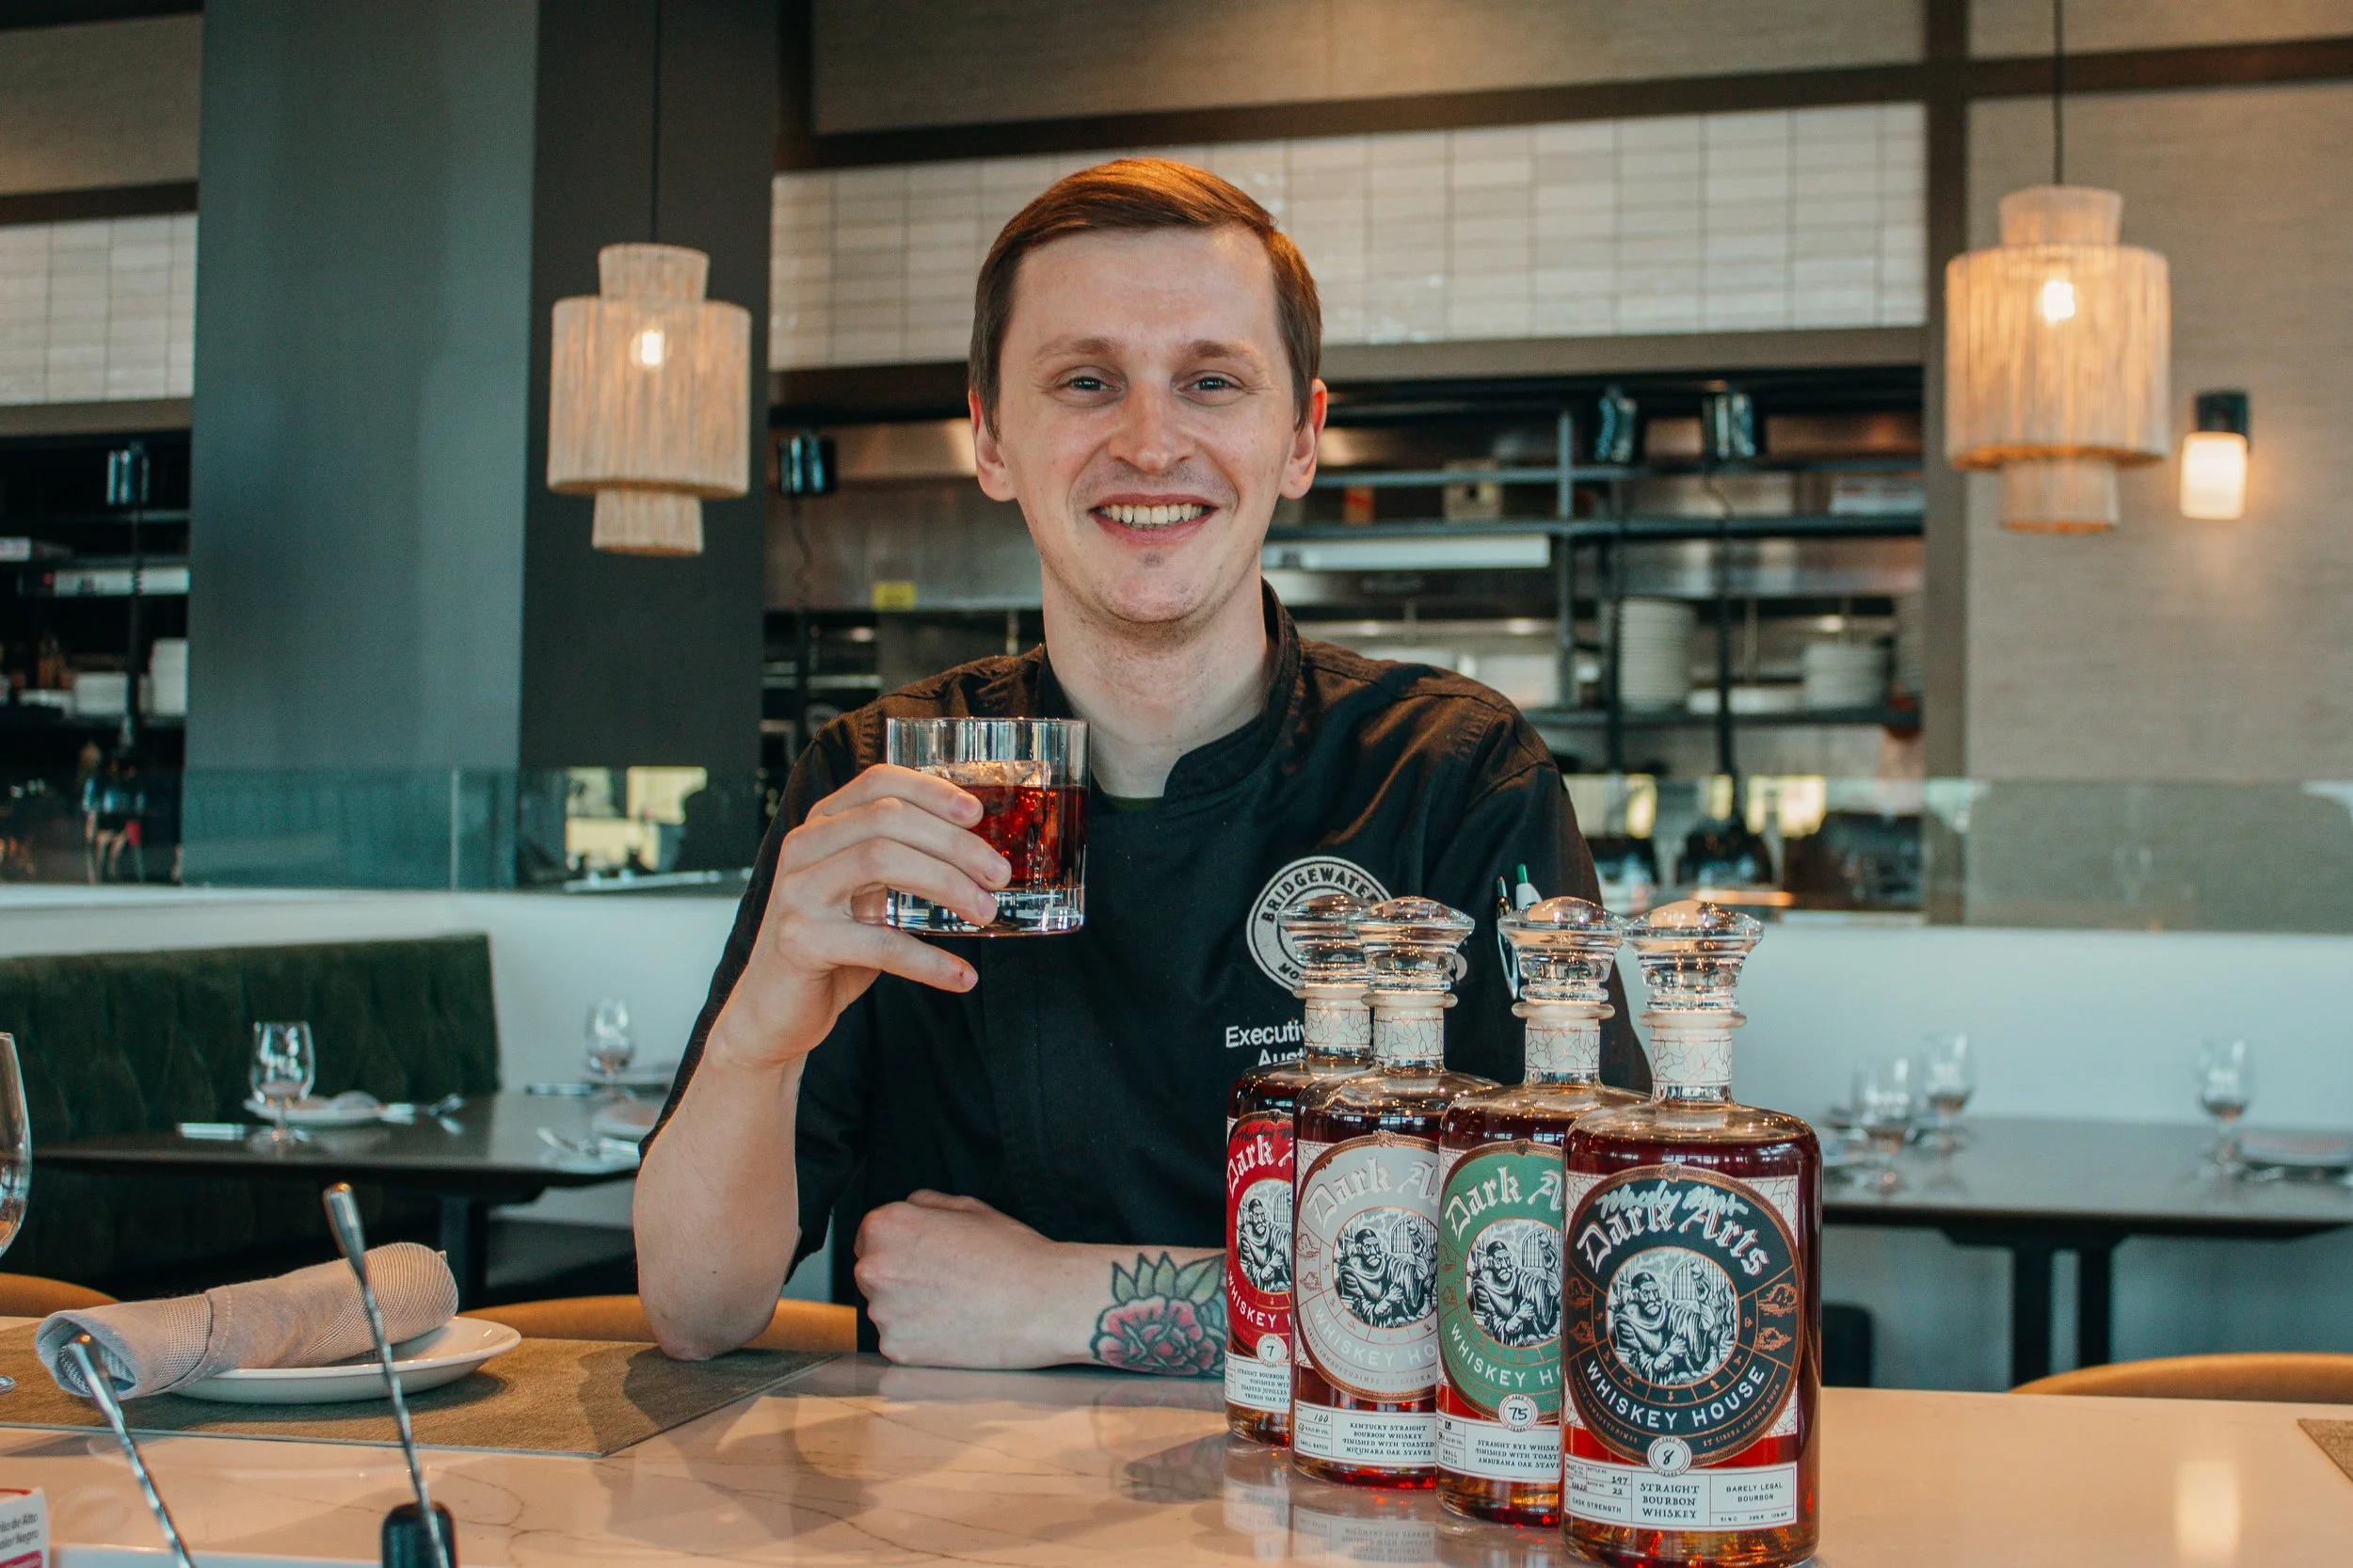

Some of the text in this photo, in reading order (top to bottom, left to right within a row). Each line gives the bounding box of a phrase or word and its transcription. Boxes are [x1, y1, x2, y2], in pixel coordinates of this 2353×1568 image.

[1225, 1019, 1305, 1048] Executi
[1258, 1048, 1305, 1066] Aust
[1227, 1134, 1273, 1199] Dark
[1306, 1156, 1391, 1230] Dark
[1445, 1166, 1523, 1241] Dark
[1577, 1199, 1674, 1273] Dark
[1228, 1271, 1277, 1328] WHISKEY
[1315, 1308, 1395, 1368] WHISKEY
[1266, 1345, 1274, 1357] 7
[1451, 1323, 1526, 1388] WHISKEY
[1587, 1361, 1765, 1430] WHISKEY HOUSE
[1350, 1422, 1386, 1431] KENTUCKY
[1353, 1431, 1385, 1439] BOURBON
[1478, 1439, 1510, 1448] STRAIGHT
[1478, 1457, 1515, 1466] AMBURANA
[1640, 1482, 1700, 1494] STRAIGHT
[1726, 1484, 1757, 1493] BARELY
[1642, 1496, 1695, 1506] BOURBON
[1737, 1494, 1774, 1503] BOURBON
[1587, 1502, 1621, 1513] STRENGTH
[1642, 1508, 1697, 1518] WHISKEY
[22, 1512, 39, 1526] Alto
[16, 1529, 40, 1544] Negro
